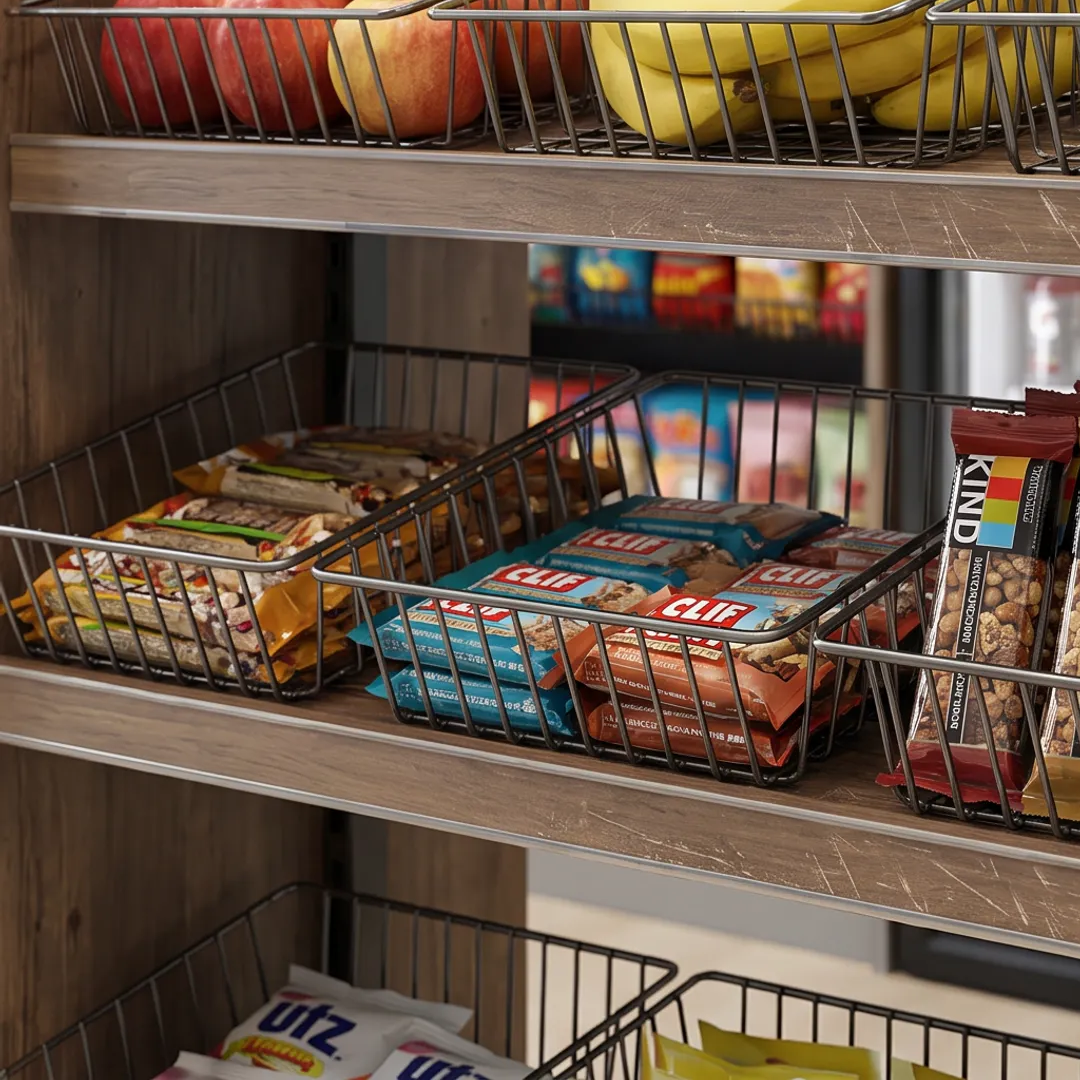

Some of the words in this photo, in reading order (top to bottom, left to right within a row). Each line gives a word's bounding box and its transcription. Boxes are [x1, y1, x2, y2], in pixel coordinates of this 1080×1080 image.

[953, 453, 996, 544] KIND
[594, 531, 665, 553] CLIF
[505, 566, 587, 589] CLIF
[759, 566, 835, 585] CLIF
[661, 597, 749, 623] CLIF
